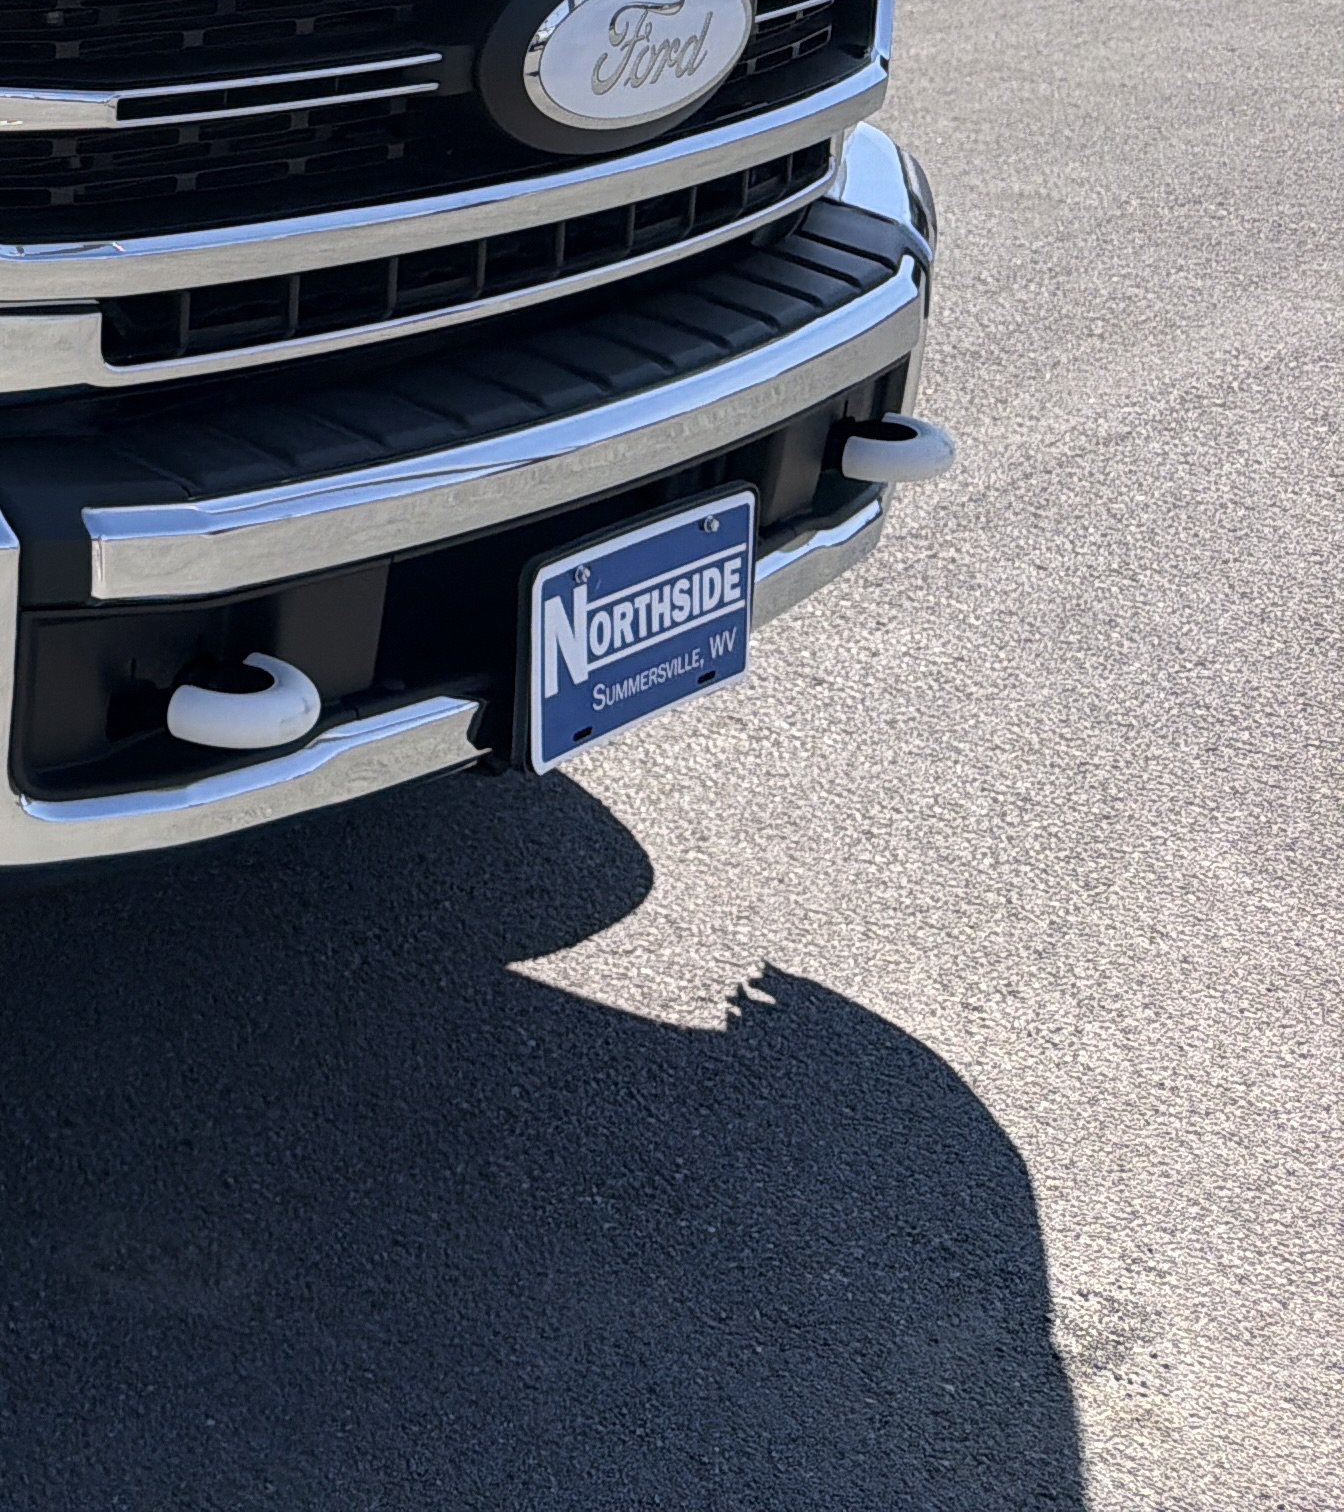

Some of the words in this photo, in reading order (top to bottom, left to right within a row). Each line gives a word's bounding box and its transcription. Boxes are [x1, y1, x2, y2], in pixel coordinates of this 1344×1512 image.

[543, 556, 742, 699] NORTHSIDE
[592, 647, 705, 711] SUMMERSVILLE,
[709, 626, 737, 660] WV
